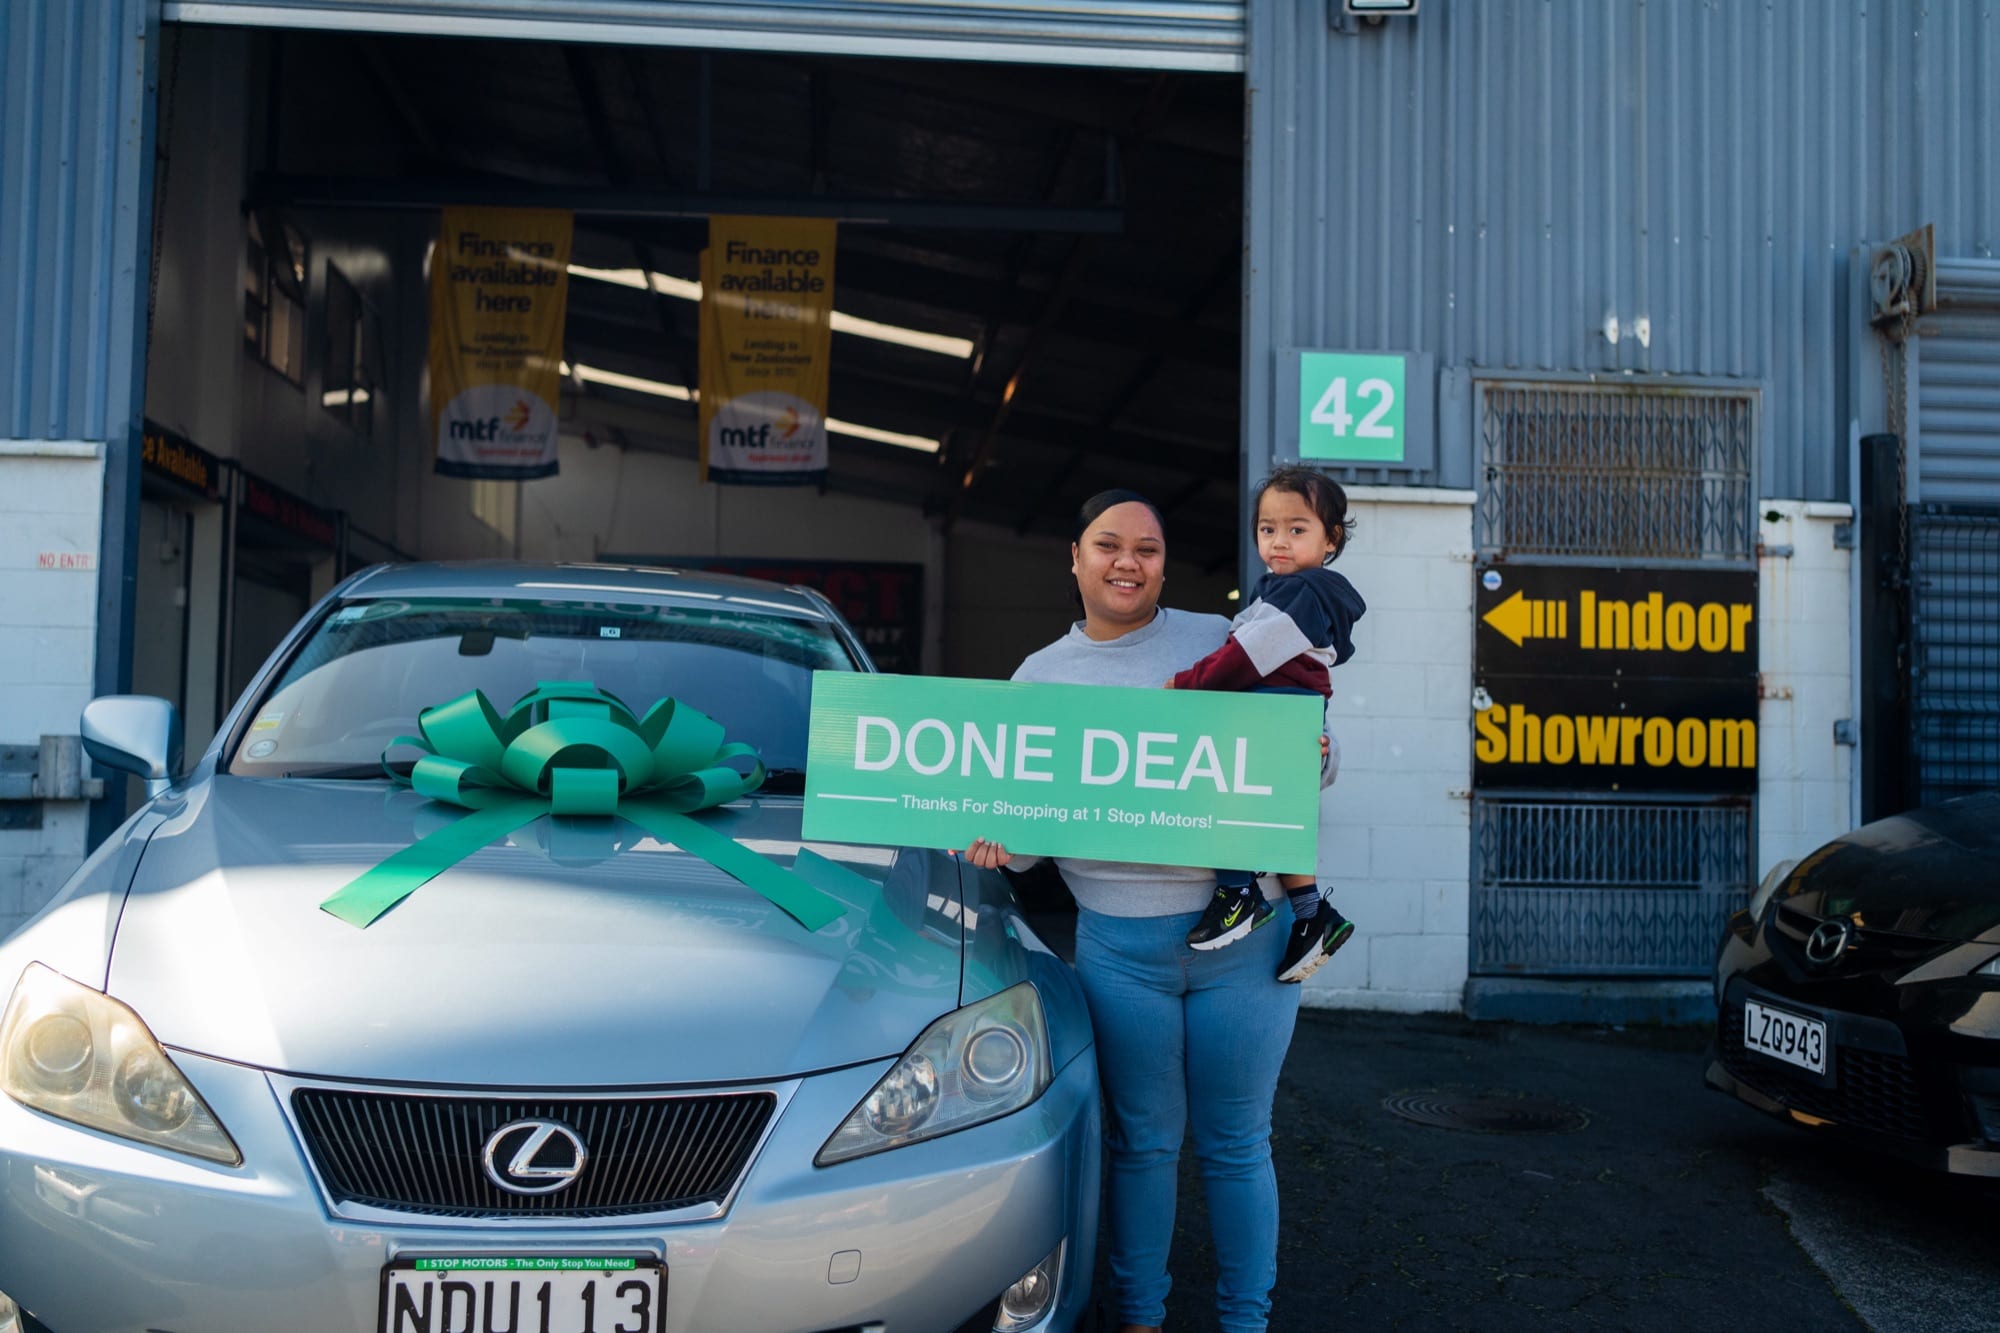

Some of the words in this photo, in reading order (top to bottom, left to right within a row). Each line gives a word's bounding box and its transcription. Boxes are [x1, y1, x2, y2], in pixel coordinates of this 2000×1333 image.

[458, 233, 554, 258] Finance
[726, 241, 820, 266] Finance
[451, 263, 558, 287] available
[720, 270, 825, 293] available
[475, 288, 531, 313] here
[744, 295, 800, 320] here
[1310, 377, 1395, 439] 42
[449, 416, 500, 442] mtf
[720, 425, 771, 448] mtf
[156, 437, 208, 488] Available
[39, 553, 56, 569] NO
[60, 553, 93, 569] ENTR
[1580, 590, 1753, 653] Indoor
[1474, 704, 1757, 768] Showroom
[854, 715, 1056, 783] DONE
[1080, 729, 1274, 796] DEAL
[901, 794, 958, 813] Thanks
[962, 798, 989, 815] For
[992, 799, 1068, 823] Shopping
[1072, 805, 1089, 821] at
[1093, 807, 1101, 821] 1
[1107, 807, 1146, 828] Stop
[1150, 809, 1213, 830] Motors!
[1747, 1009, 1822, 1066] LZQ943
[431, 1258, 460, 1268] STOP
[462, 1258, 508, 1268] MOTORS
[516, 1258, 534, 1268] The
[536, 1258, 559, 1270] Only
[561, 1258, 584, 1270] Stop
[585, 1258, 603, 1268] You
[605, 1258, 630, 1268] Need
[394, 1281, 651, 1333] NDU113
